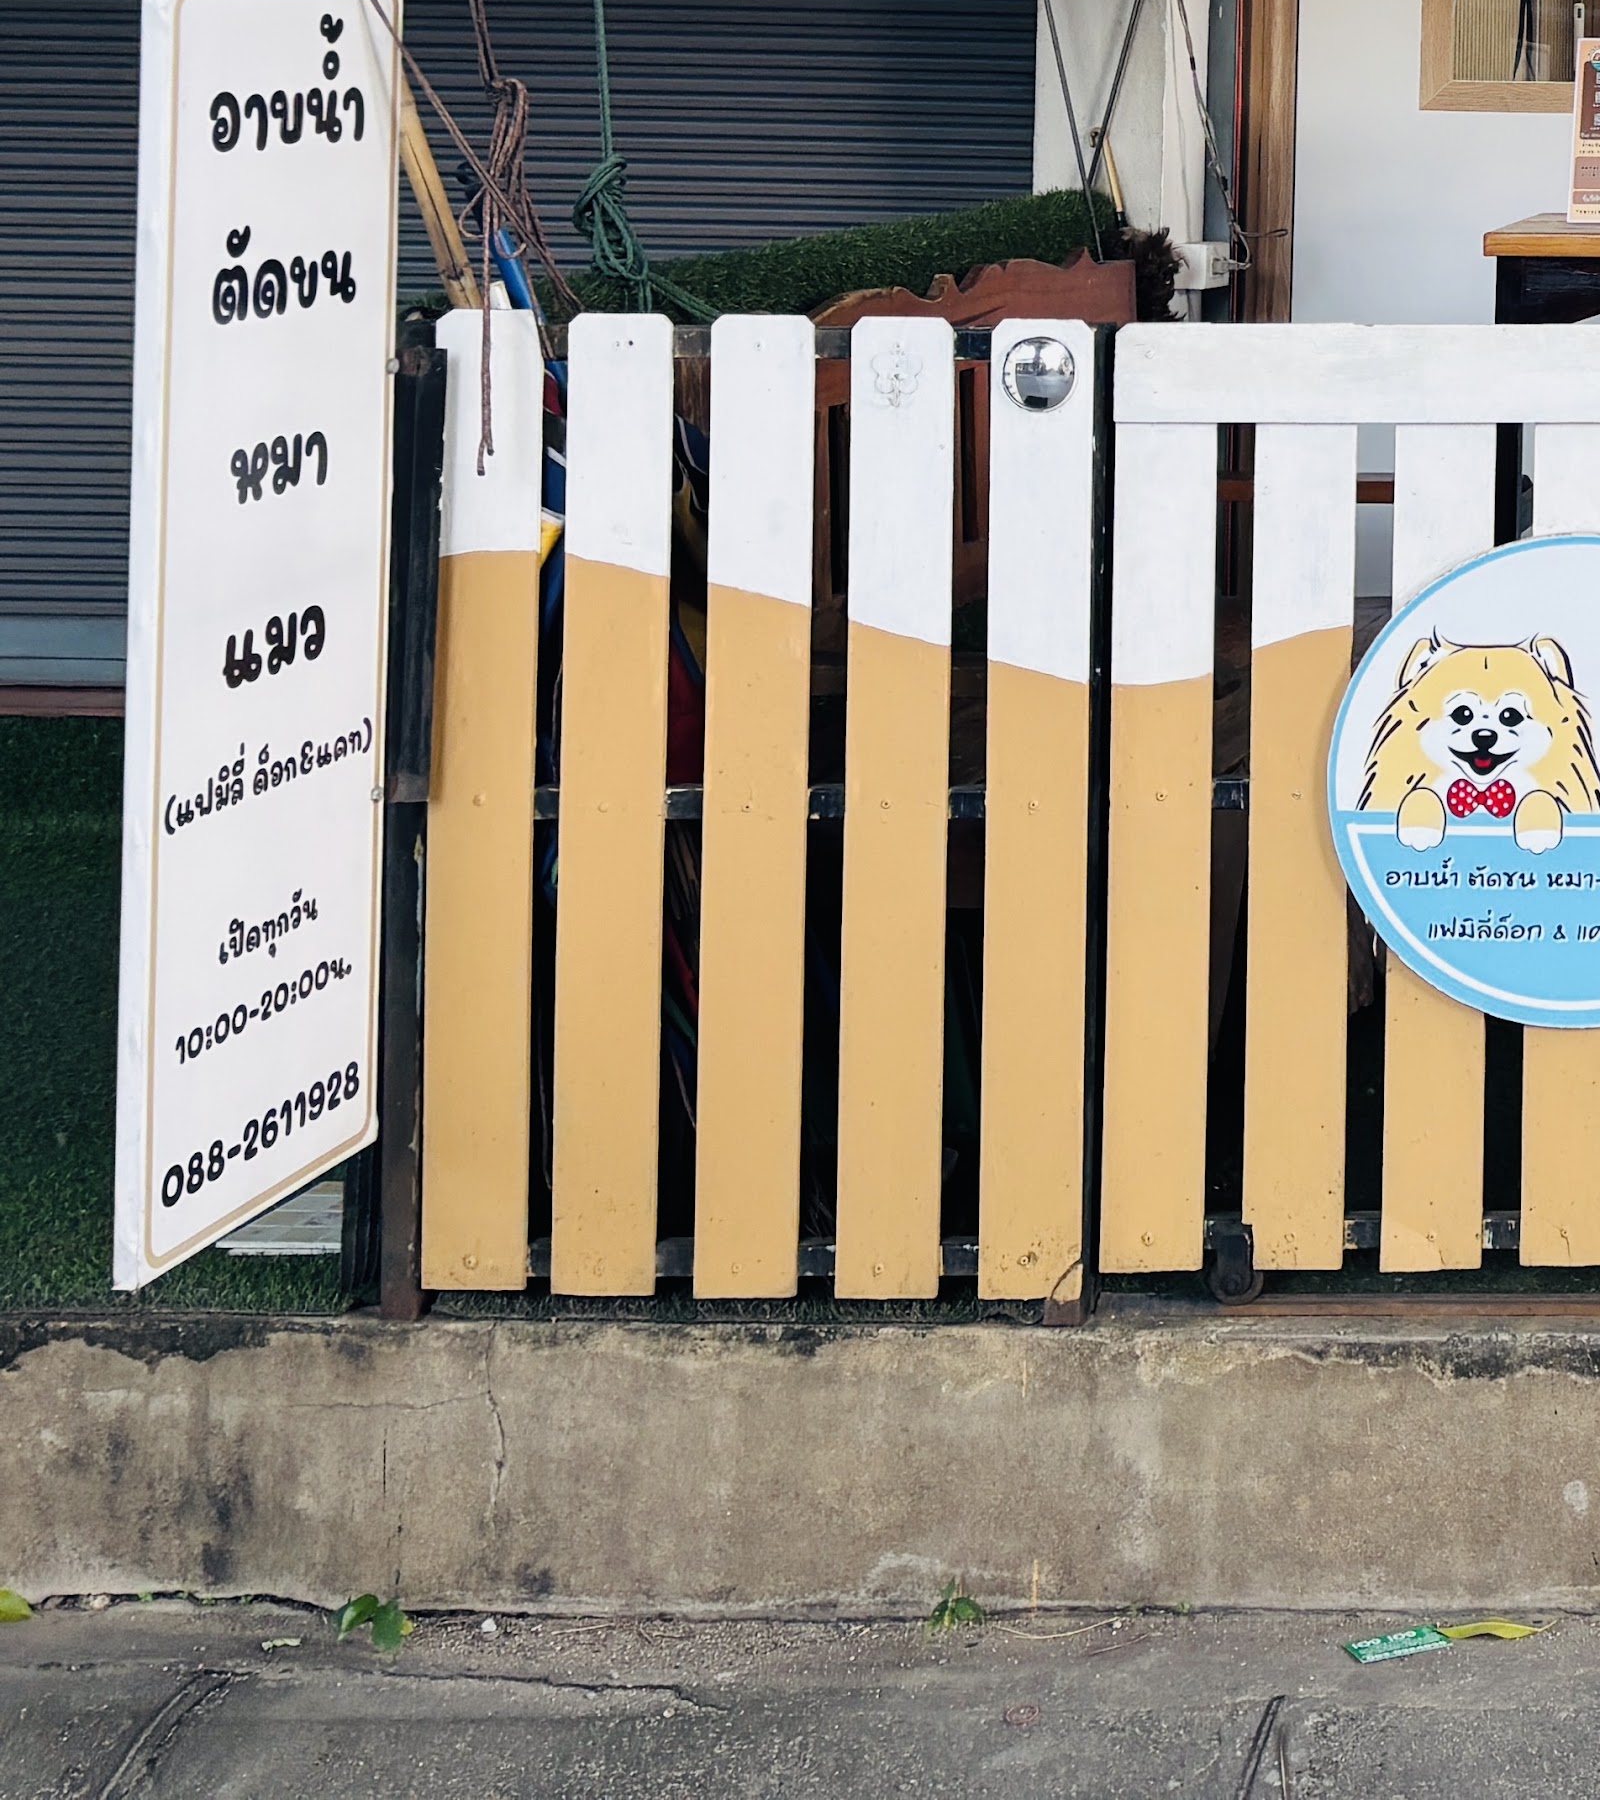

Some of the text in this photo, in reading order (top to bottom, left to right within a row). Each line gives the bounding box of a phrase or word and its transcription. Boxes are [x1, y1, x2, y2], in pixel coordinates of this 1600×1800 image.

[209, 13, 365, 153] อาบน้ำ
[212, 225, 357, 325] ตัดขน
[230, 431, 328, 504] หมา
[222, 605, 326, 689] แมว
[1386, 857, 1458, 887] อาบน้ำ
[1468, 865, 1536, 888] ตัดขน
[218, 887, 318, 966] เปิดทุกวัน
[1552, 924, 1566, 940] &
[175, 957, 352, 1064] 10:00-20:00น.
[161, 1061, 360, 1208] 088-2611928
